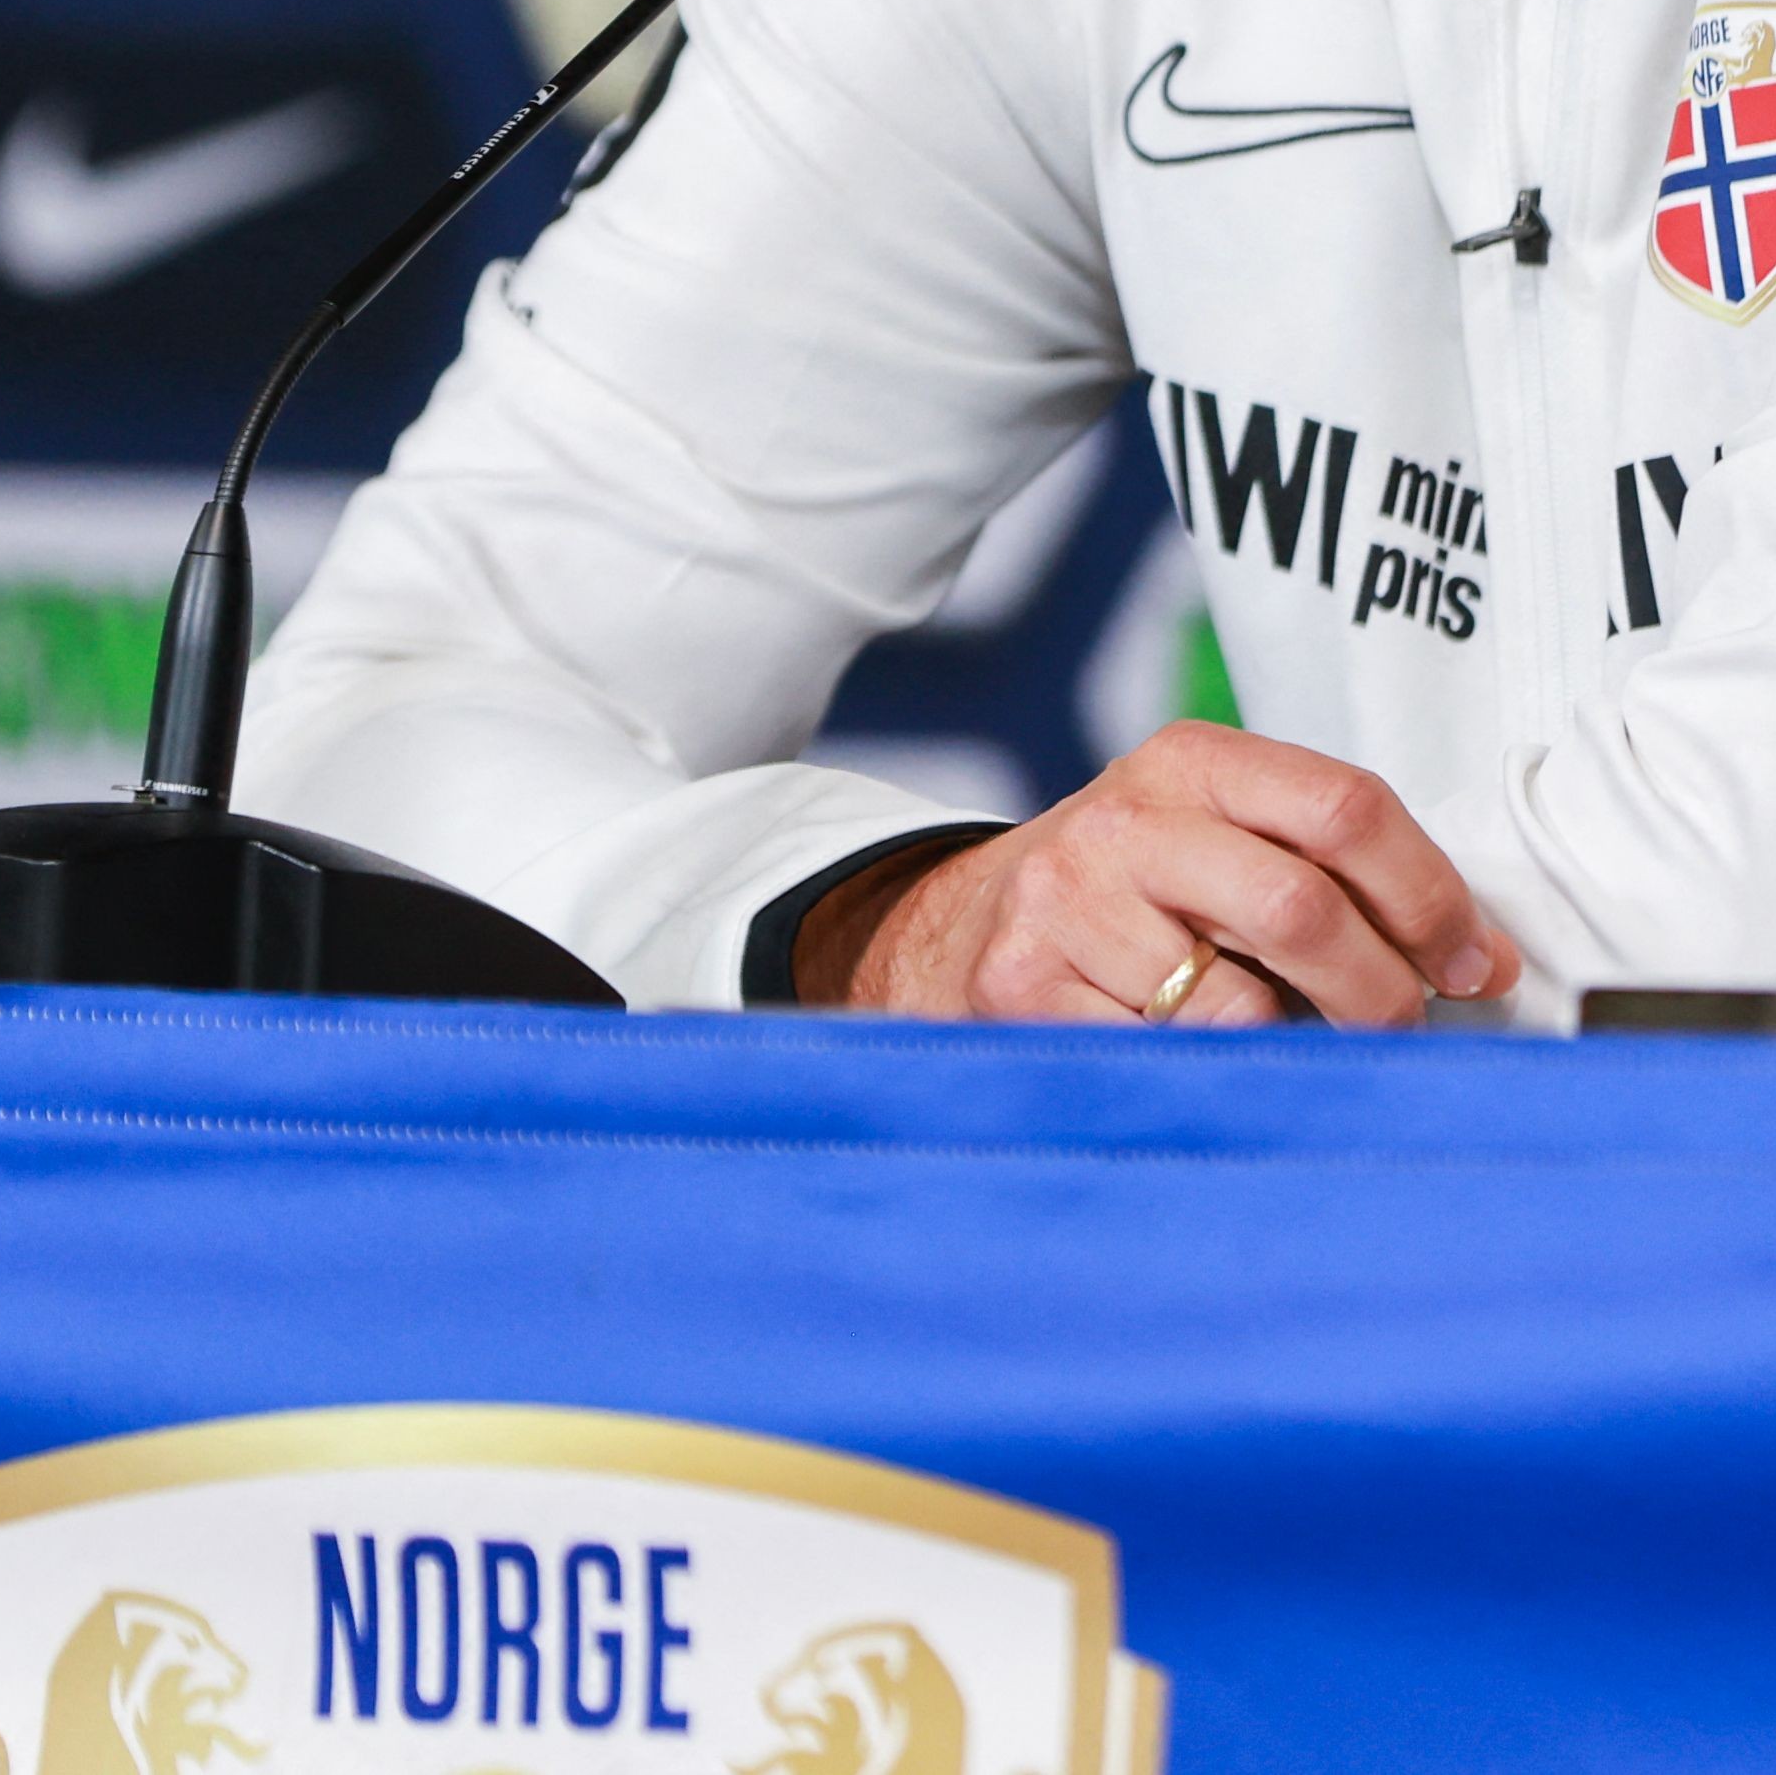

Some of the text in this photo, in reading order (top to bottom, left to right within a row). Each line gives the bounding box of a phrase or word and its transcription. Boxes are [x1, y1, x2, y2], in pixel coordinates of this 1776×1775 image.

[1689, 16, 1731, 53] ORGE
[449, 106, 531, 180] SENNHEISER
[1378, 458, 1489, 556] min
[1351, 541, 1483, 643] pris
[311, 1530, 696, 1735] NORGE
